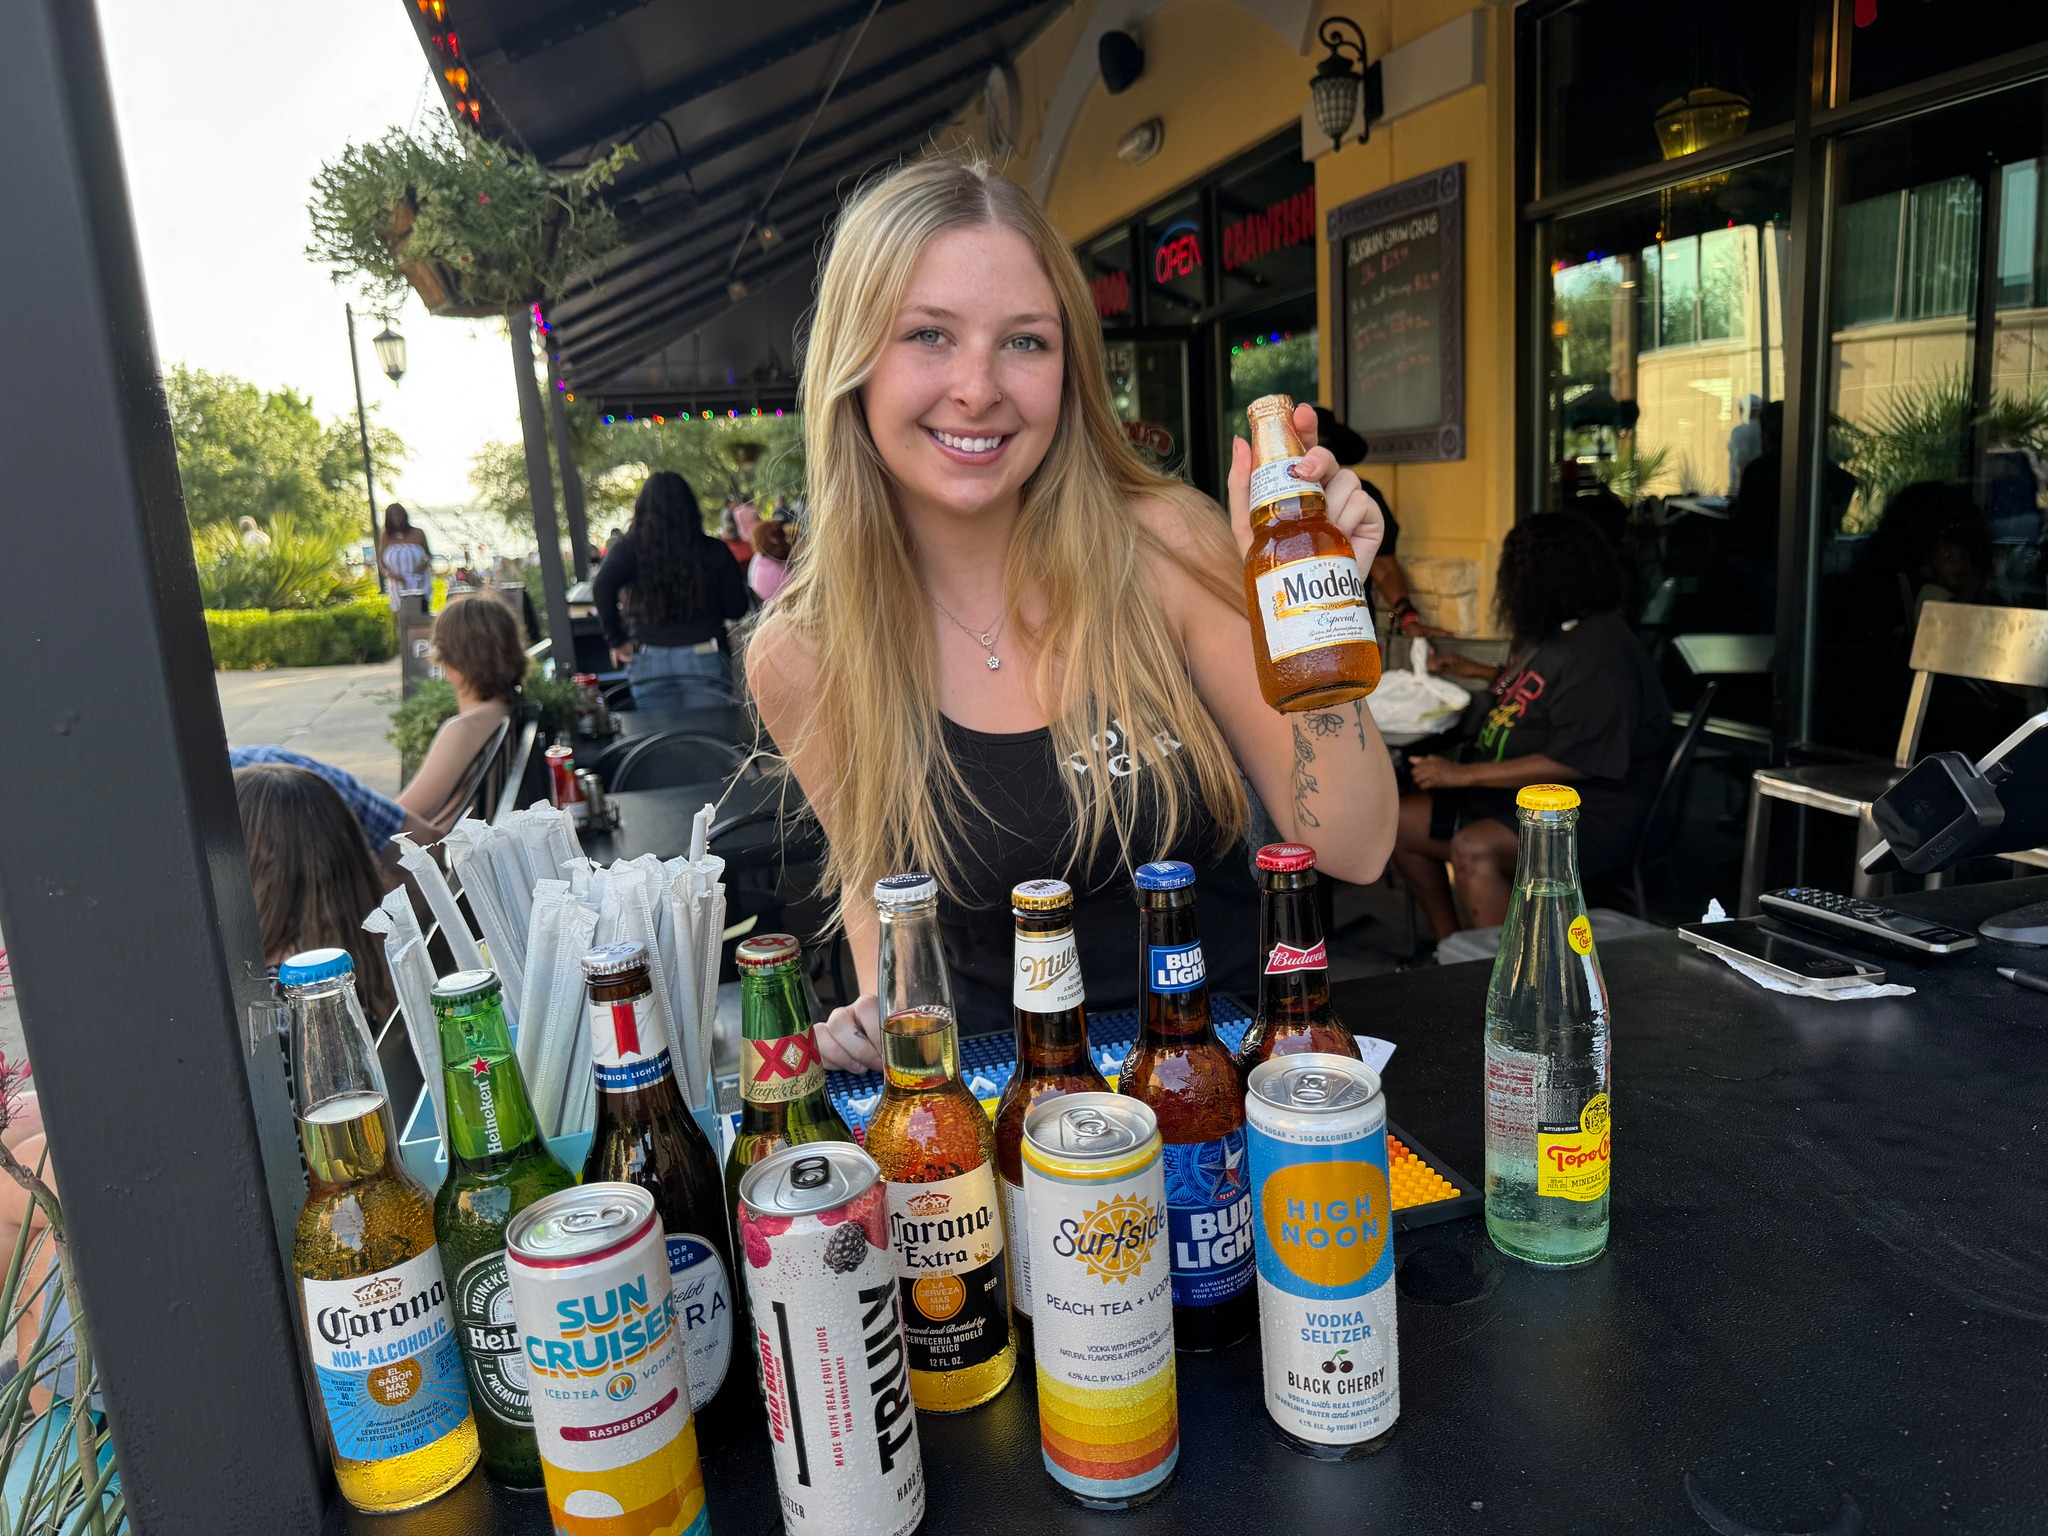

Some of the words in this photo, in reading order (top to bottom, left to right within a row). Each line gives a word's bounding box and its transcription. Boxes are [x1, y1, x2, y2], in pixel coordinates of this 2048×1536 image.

[1223, 184, 1315, 271] CRAWFISH
[1155, 234, 1202, 283] OPEN
[1309, 561, 1341, 573] CERVEZA
[1282, 568, 1363, 606] Modelo
[742, 937, 794, 947] XX
[1571, 925, 1587, 940] Topo
[1020, 946, 1077, 985] Mille
[1166, 947, 1203, 970] BUD
[1158, 959, 1206, 985] LIGHT
[751, 1025, 821, 1081] XX
[595, 1070, 628, 1081] SUPERIOR
[631, 1065, 656, 1079] LIGHT
[658, 1056, 670, 1069] BEER
[478, 1080, 502, 1156] Heineken
[1264, 1126, 1287, 1138] SUGAR
[1316, 1132, 1353, 1142] CALORIES
[1547, 1145, 1597, 1172] Topo
[1571, 1173, 1601, 1187] MINERAL
[1220, 1189, 1236, 1199] TEXAS
[1190, 1193, 1252, 1241] BUD
[1287, 1194, 1371, 1223] HIGH
[1053, 1201, 1166, 1258] Surfside
[1282, 1218, 1378, 1249] NOON
[1176, 1219, 1255, 1269] LIGH
[904, 1246, 968, 1268] Extra
[941, 1269, 954, 1277] 1925
[1200, 1279, 1225, 1287] ALWAYS
[919, 1286, 960, 1297] CERVEZA
[984, 1277, 998, 1292] BEER
[1211, 1281, 1234, 1291] SIMPLE
[556, 1274, 649, 1337] SUN
[930, 1296, 950, 1304] MAS
[1047, 1293, 1095, 1316] PEACH
[1100, 1301, 1133, 1316] TEA
[317, 1280, 447, 1349] Corona
[903, 1323, 930, 1334] Brewed
[930, 1326, 945, 1335] and
[946, 1317, 977, 1333] Bottled
[976, 1316, 987, 1329] by
[1305, 1311, 1364, 1328] VODKA
[332, 1316, 447, 1368] NON-ALCOHOLIC
[526, 1290, 677, 1377] CRUISER
[816, 1325, 828, 1354] JUICE
[905, 1335, 951, 1345] CERVECERIA
[953, 1328, 983, 1343] MODELO
[1111, 1343, 1127, 1352] WITH
[1128, 1336, 1148, 1348] PEACH
[1301, 1325, 1371, 1344] SELTZER
[694, 1347, 703, 1356] 95
[704, 1340, 719, 1352] CALS
[930, 1343, 960, 1354] MEXICO
[1060, 1348, 1087, 1360] NATURAL
[1124, 1343, 1153, 1359] ARTIFICIAL
[758, 1325, 778, 1394] BERRY
[929, 1358, 938, 1367] 12
[939, 1358, 950, 1367] FL.
[951, 1356, 964, 1366] OZ.
[378, 1370, 413, 1388] SABOR
[387, 1367, 401, 1377] EL
[545, 1388, 571, 1400] ICED
[573, 1389, 599, 1399] TEA
[642, 1346, 676, 1380] VODKA
[820, 1357, 834, 1385] FRUIT
[858, 1276, 914, 1476] TRULY
[1287, 1370, 1331, 1395] BLACK
[1337, 1367, 1385, 1395] CHERRY
[386, 1380, 408, 1393] MAS
[836, 1355, 851, 1411] CONCENTRATE
[341, 1392, 350, 1400] 60
[386, 1389, 410, 1401] FINO
[826, 1386, 838, 1411] REAL
[1288, 1393, 1310, 1406] VODKA
[1311, 1401, 1331, 1409] with
[1352, 1397, 1371, 1407] FRUIT
[361, 1426, 399, 1436] CERVECERIA
[400, 1415, 426, 1428] MODELO
[427, 1401, 448, 1418] MEXICO
[366, 1417, 392, 1428] Brewed
[589, 1406, 660, 1439] RASPBERRY
[768, 1393, 785, 1443] WILD
[1306, 1409, 1330, 1418] WATER
[1331, 1410, 1349, 1419] and
[1351, 1404, 1380, 1417] NATURAL
[397, 1428, 412, 1437] WITH
[413, 1418, 434, 1431] NATURAL
[829, 1414, 841, 1439] WITH
[846, 1414, 854, 1433] FROM
[1327, 1424, 1335, 1433] by
[1336, 1423, 1357, 1431] VOLUME
[389, 1445, 398, 1453] 12
[414, 1436, 428, 1446] OZ.
[832, 1441, 845, 1467] MADE
[897, 1472, 916, 1502] HARD
